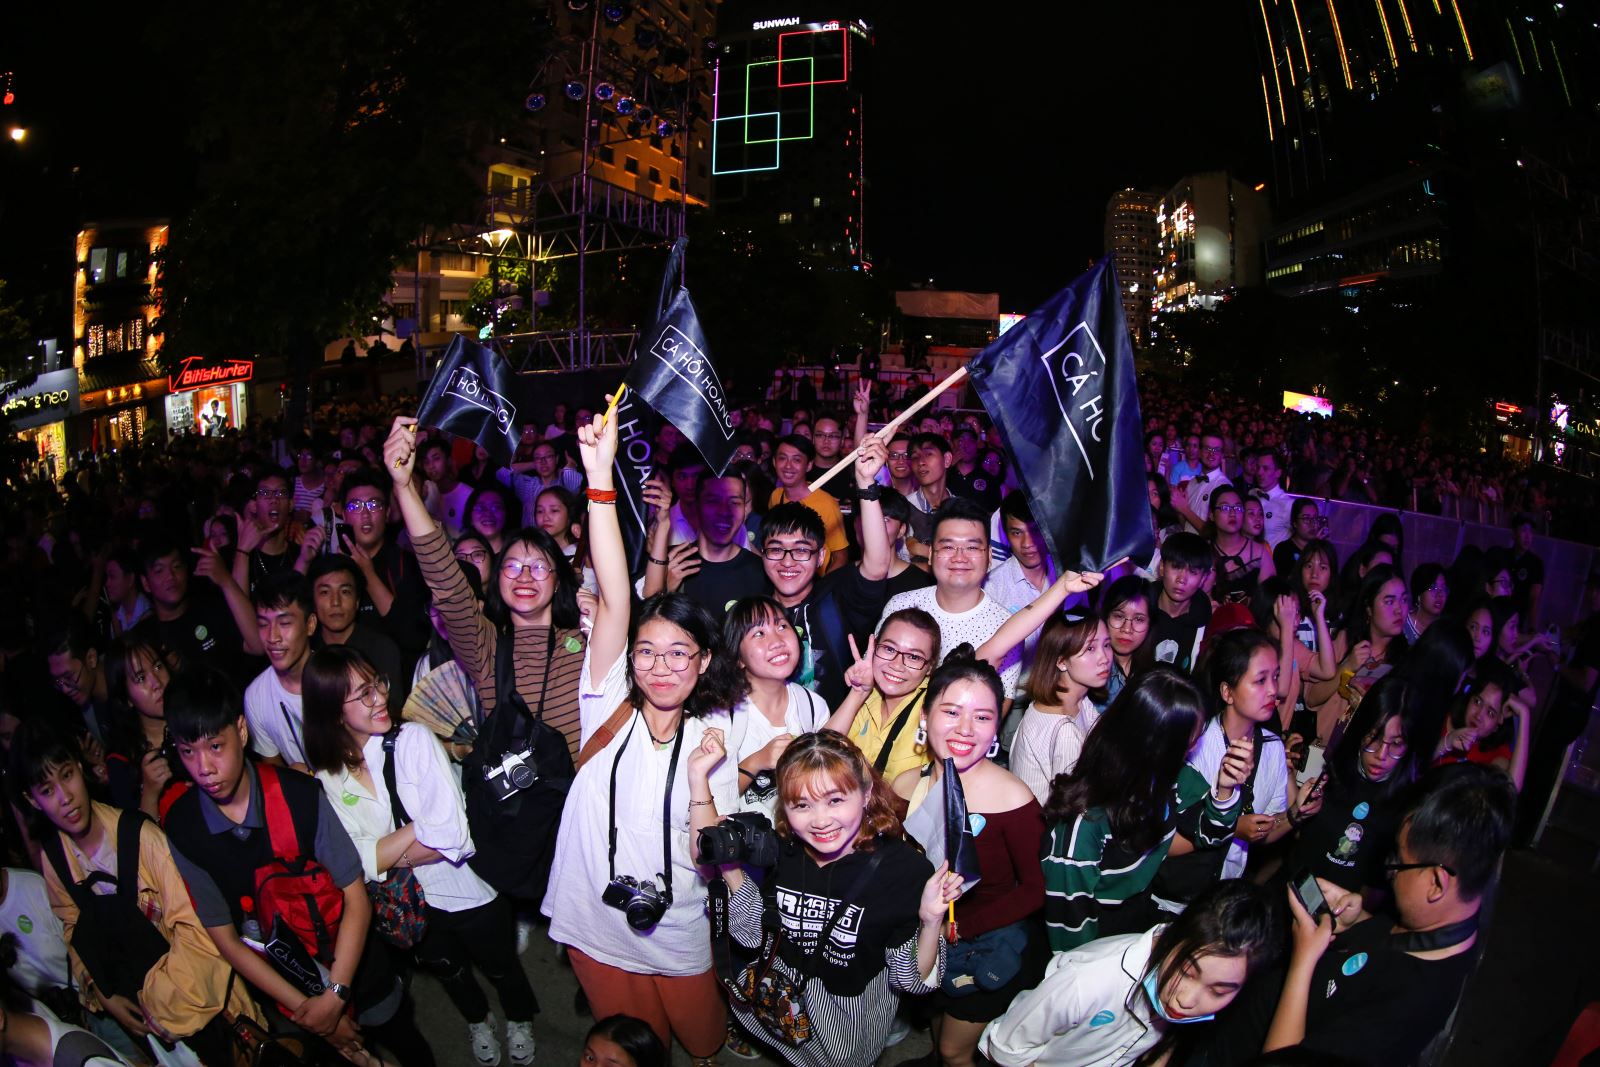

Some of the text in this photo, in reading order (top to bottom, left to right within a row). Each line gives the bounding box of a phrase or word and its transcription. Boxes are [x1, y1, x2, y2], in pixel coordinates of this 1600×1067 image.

[753, 17, 799, 30] SUNWAH
[661, 337, 683, 358] CÁ
[677, 351, 705, 378] HỒI
[1062, 352, 1099, 396] CÁ
[43, 390, 69, 405] neo
[618, 418, 653, 489] HOA
[763, 932, 775, 960] Canon
[724, 978, 747, 1001] Canon
